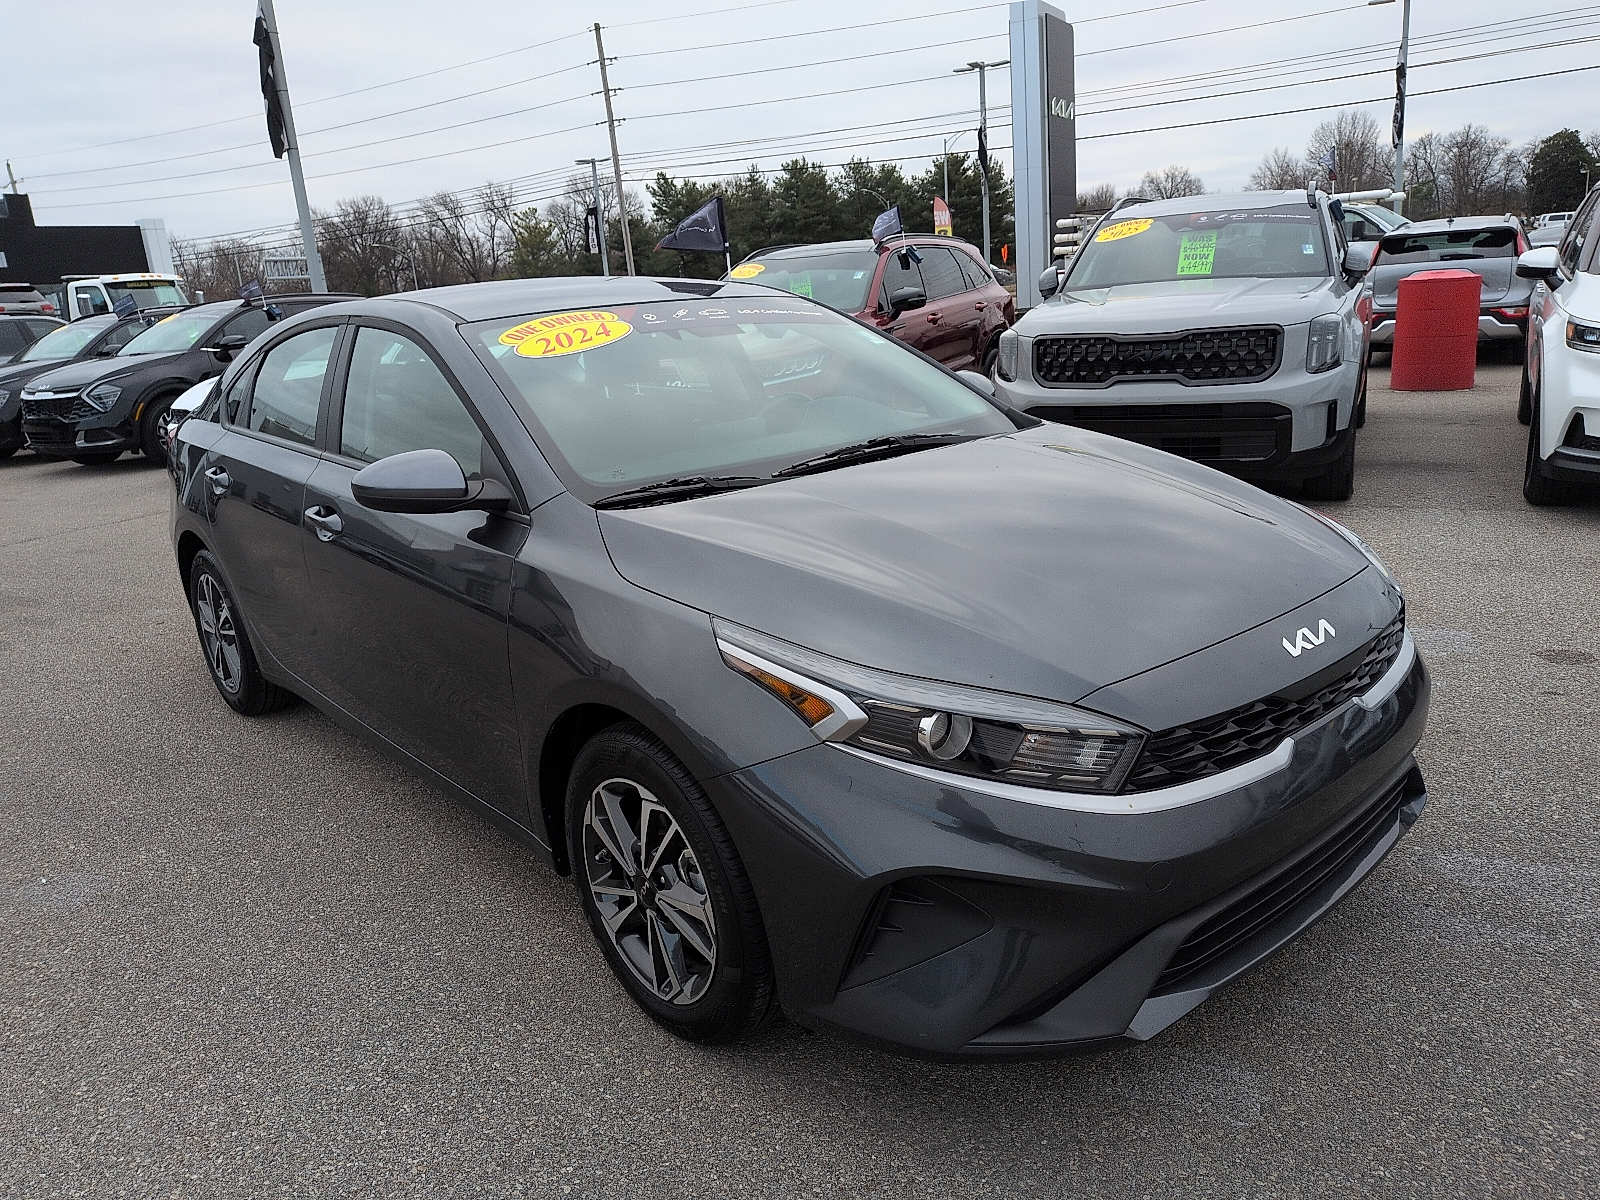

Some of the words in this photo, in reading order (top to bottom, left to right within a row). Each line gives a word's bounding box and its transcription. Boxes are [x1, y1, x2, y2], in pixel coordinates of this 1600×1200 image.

[1187, 234, 1213, 243] WAS
[1183, 253, 1211, 261] NOW
[505, 324, 543, 342] ONE
[540, 312, 607, 329] OWNER
[535, 322, 613, 355] 2024
[1282, 618, 1336, 658] KIA
